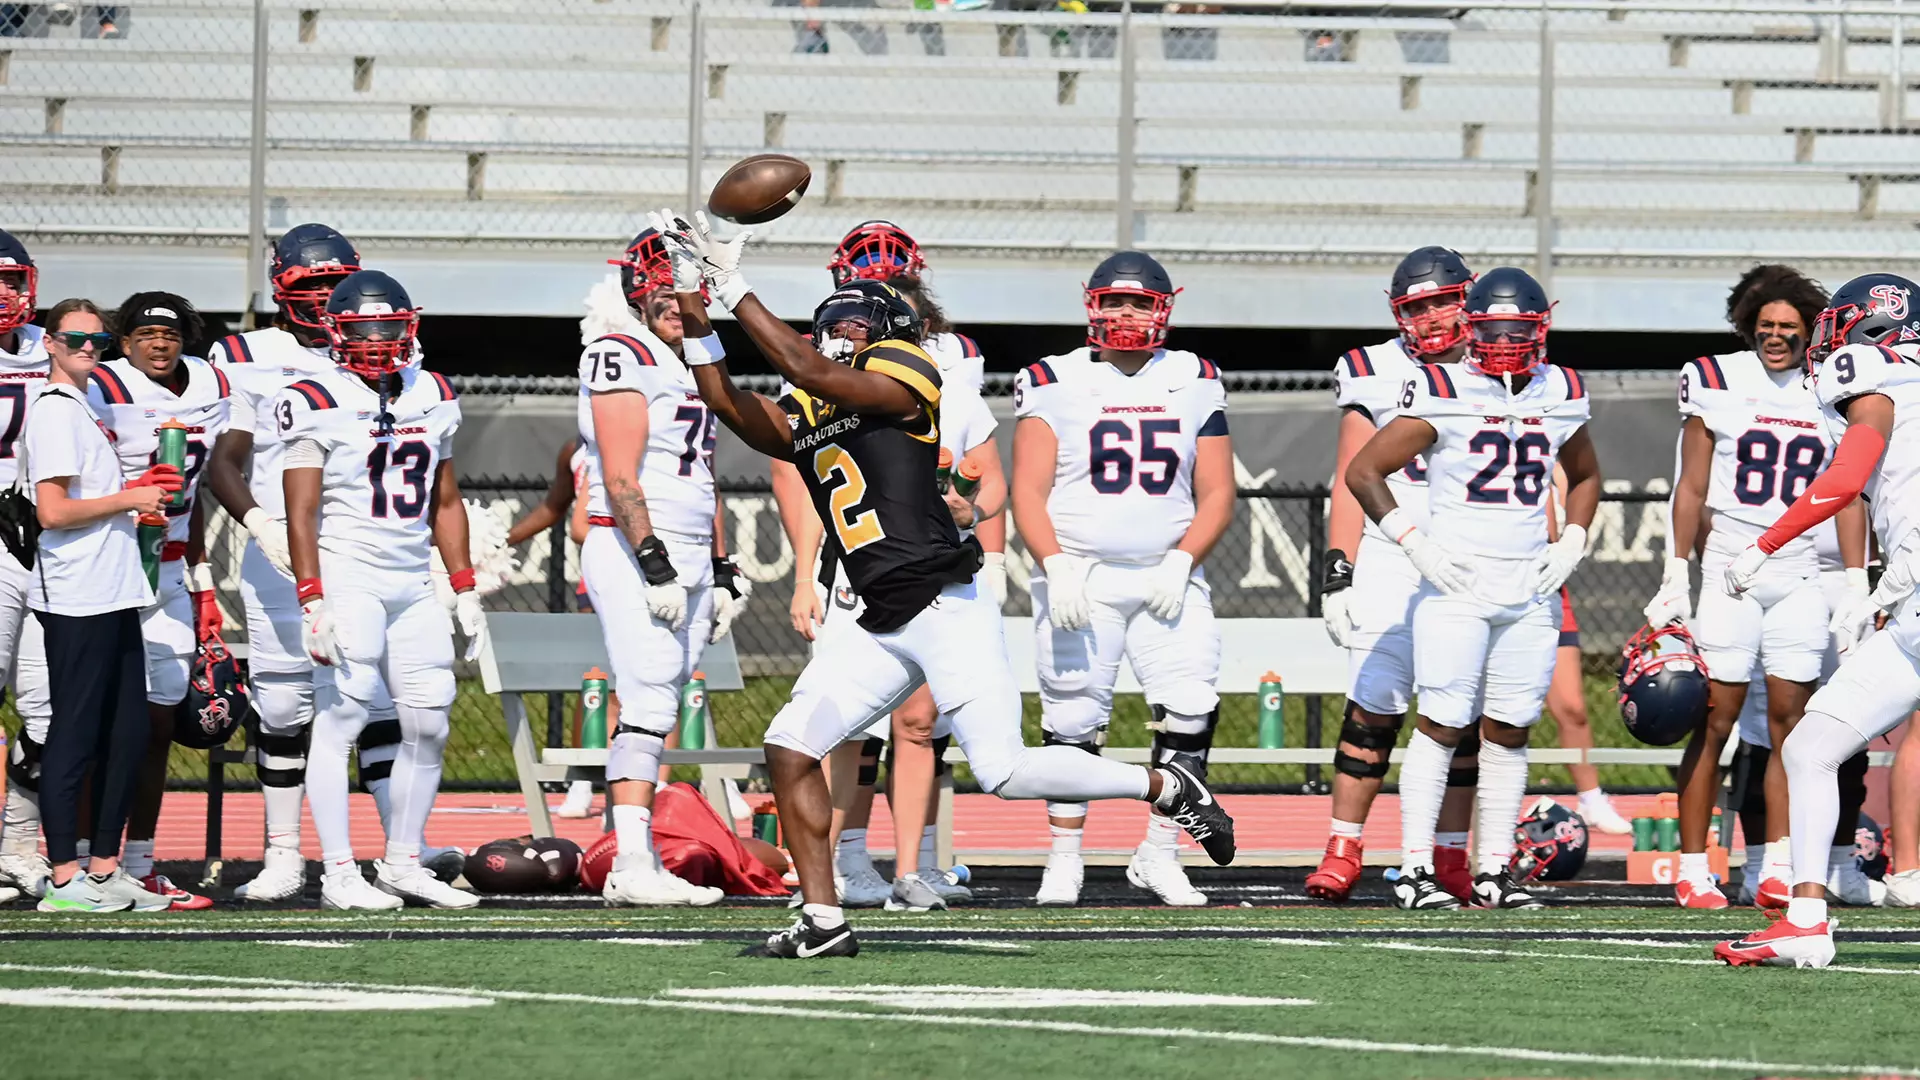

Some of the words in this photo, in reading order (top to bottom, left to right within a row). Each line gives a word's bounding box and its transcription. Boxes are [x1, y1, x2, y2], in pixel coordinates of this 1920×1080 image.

[587, 352, 622, 383] 75
[1834, 352, 1857, 386] 9
[793, 413, 861, 454] MARAUDERS
[1089, 419, 1181, 496] 65
[1466, 430, 1551, 506] 26
[1733, 429, 1827, 508] 88
[366, 439, 432, 520] 13
[813, 442, 887, 556] 2
[1652, 858, 1672, 884] G
